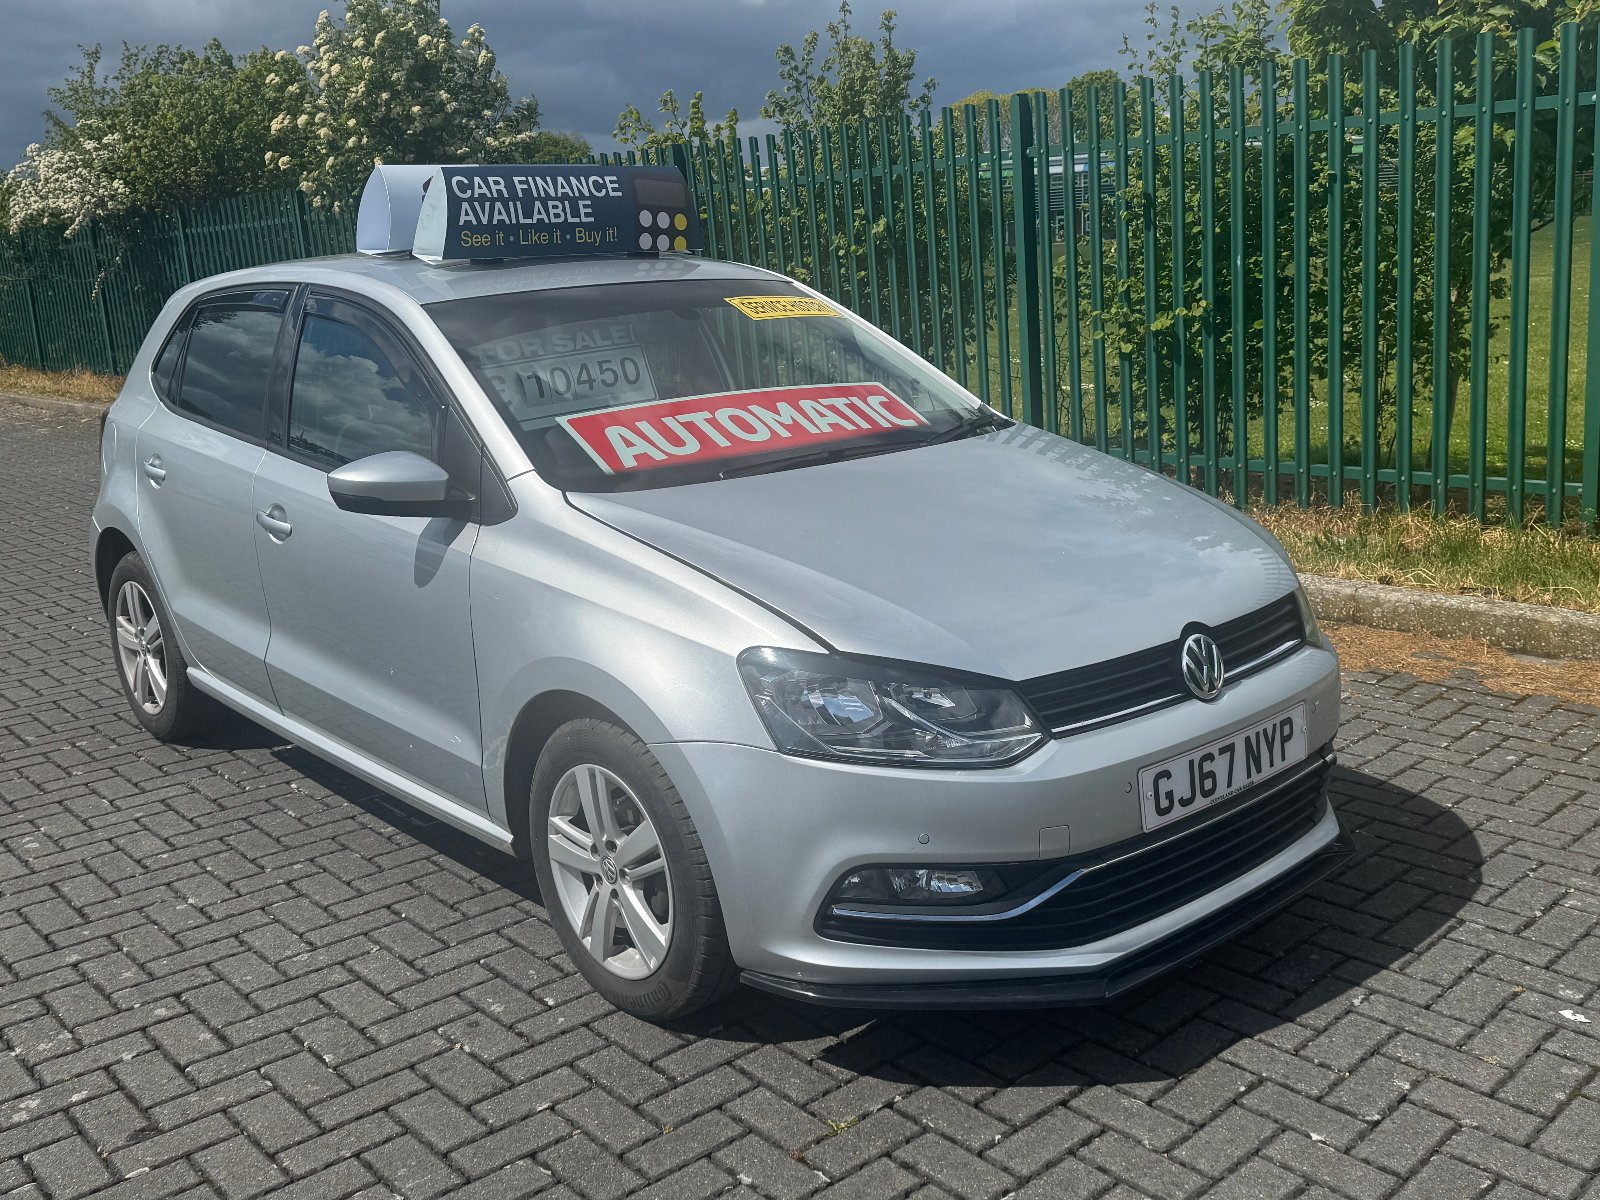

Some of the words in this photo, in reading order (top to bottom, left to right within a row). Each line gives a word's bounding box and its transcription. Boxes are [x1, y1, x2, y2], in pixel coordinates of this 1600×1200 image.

[451, 175, 509, 199] CAR
[513, 175, 623, 198] FINANCE
[458, 200, 595, 226] AVAILABLE
[461, 230, 491, 247] See
[496, 229, 505, 245] it
[519, 229, 549, 245] Like
[553, 227, 562, 243] it
[575, 228, 603, 247] Buy
[606, 226, 618, 242] it!
[741, 300, 794, 314] SERVICE
[476, 337, 546, 364] FOR
[551, 325, 627, 351] SALE
[604, 395, 918, 469] AUTOMATIC
[1152, 742, 1235, 817] GJ67
[1244, 717, 1294, 779] NYP
